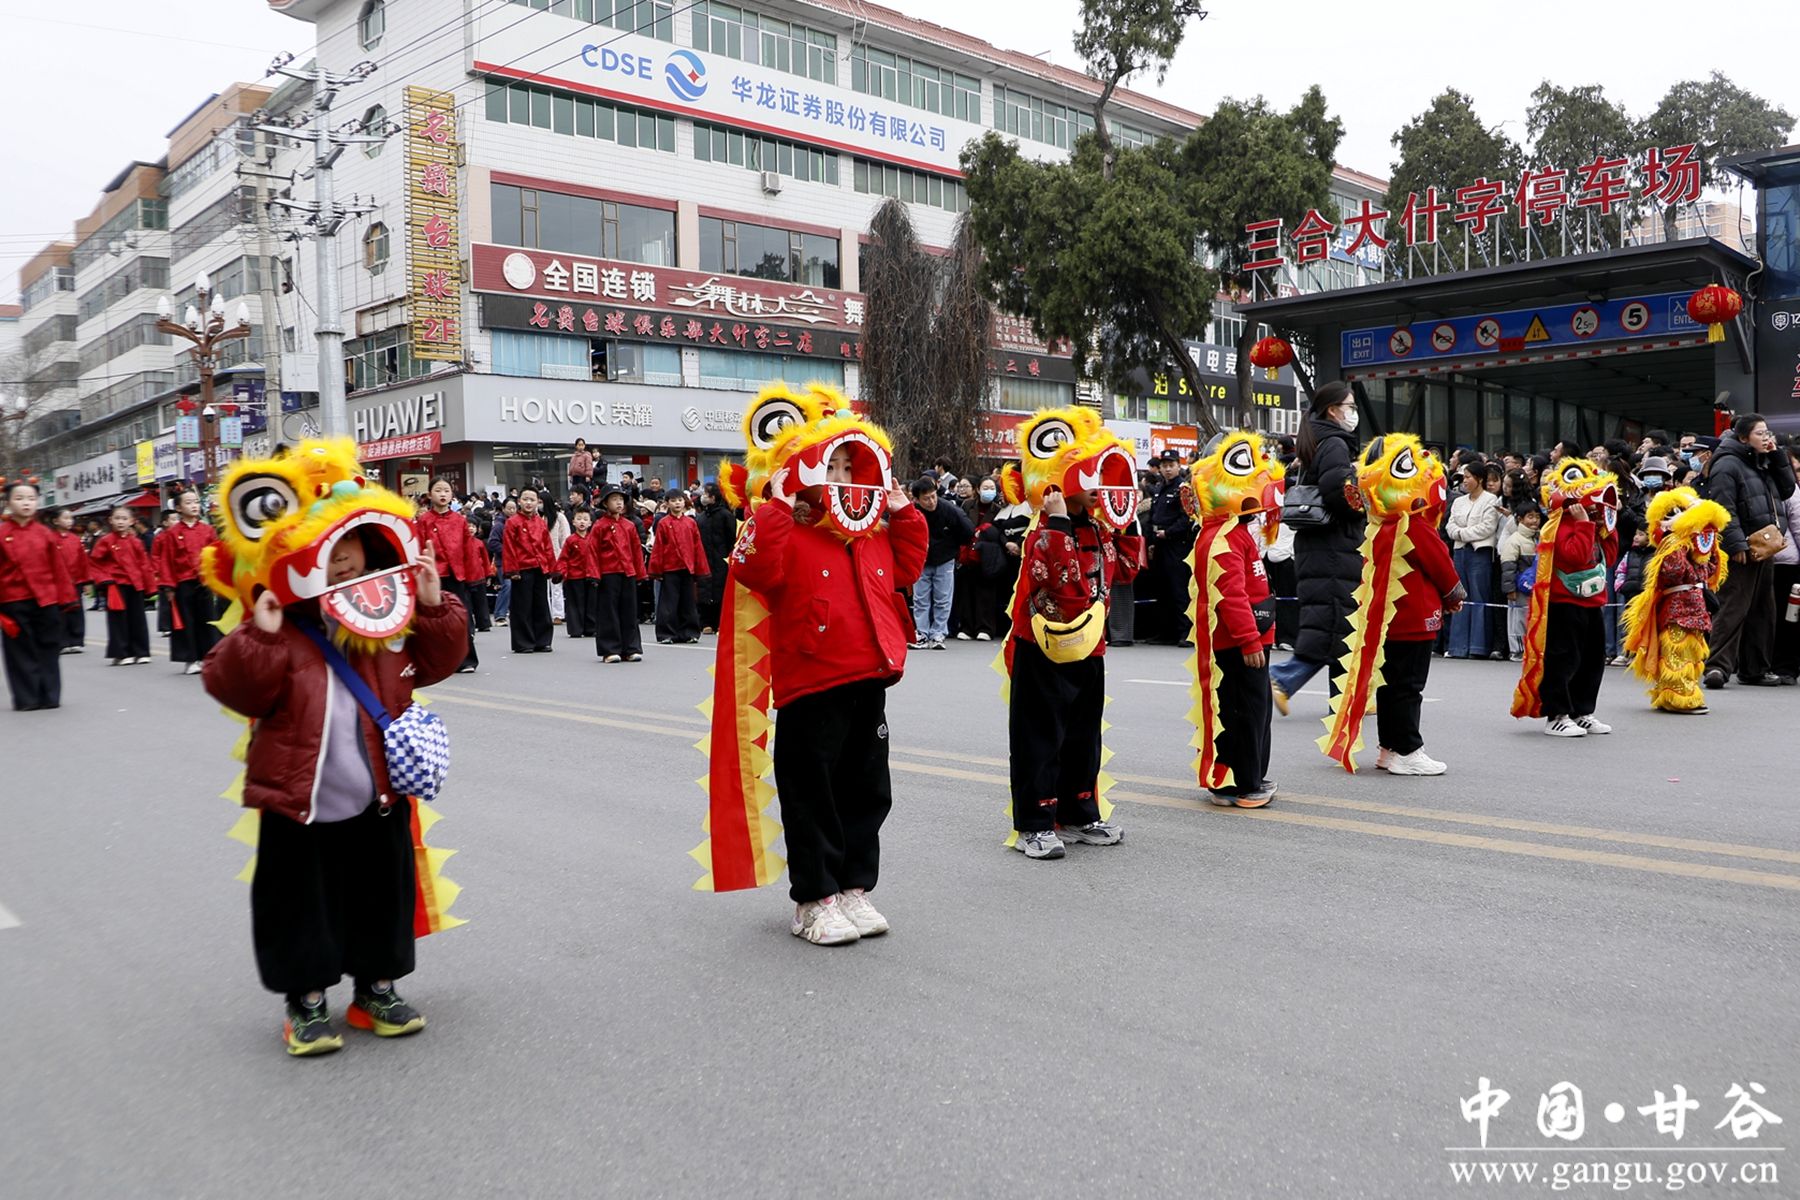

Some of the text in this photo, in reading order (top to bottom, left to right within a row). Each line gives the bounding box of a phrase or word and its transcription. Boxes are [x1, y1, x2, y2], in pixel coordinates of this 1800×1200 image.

[581, 43, 947, 152] CDSE 华龙证券股份有限公司
[1242, 142, 1702, 272] 三合大什字停车场
[543, 259, 657, 302] 全国连锁
[529, 302, 814, 354] 名爵台球俱乐部大什字二店
[1627, 307, 1643, 326] 5
[1673, 314, 1695, 325] ENTE
[1352, 336, 1372, 349] 出口
[1353, 350, 1370, 359] EXIT
[354, 391, 445, 443] HUAWEI
[500, 396, 653, 428] HONOR 荣耀
